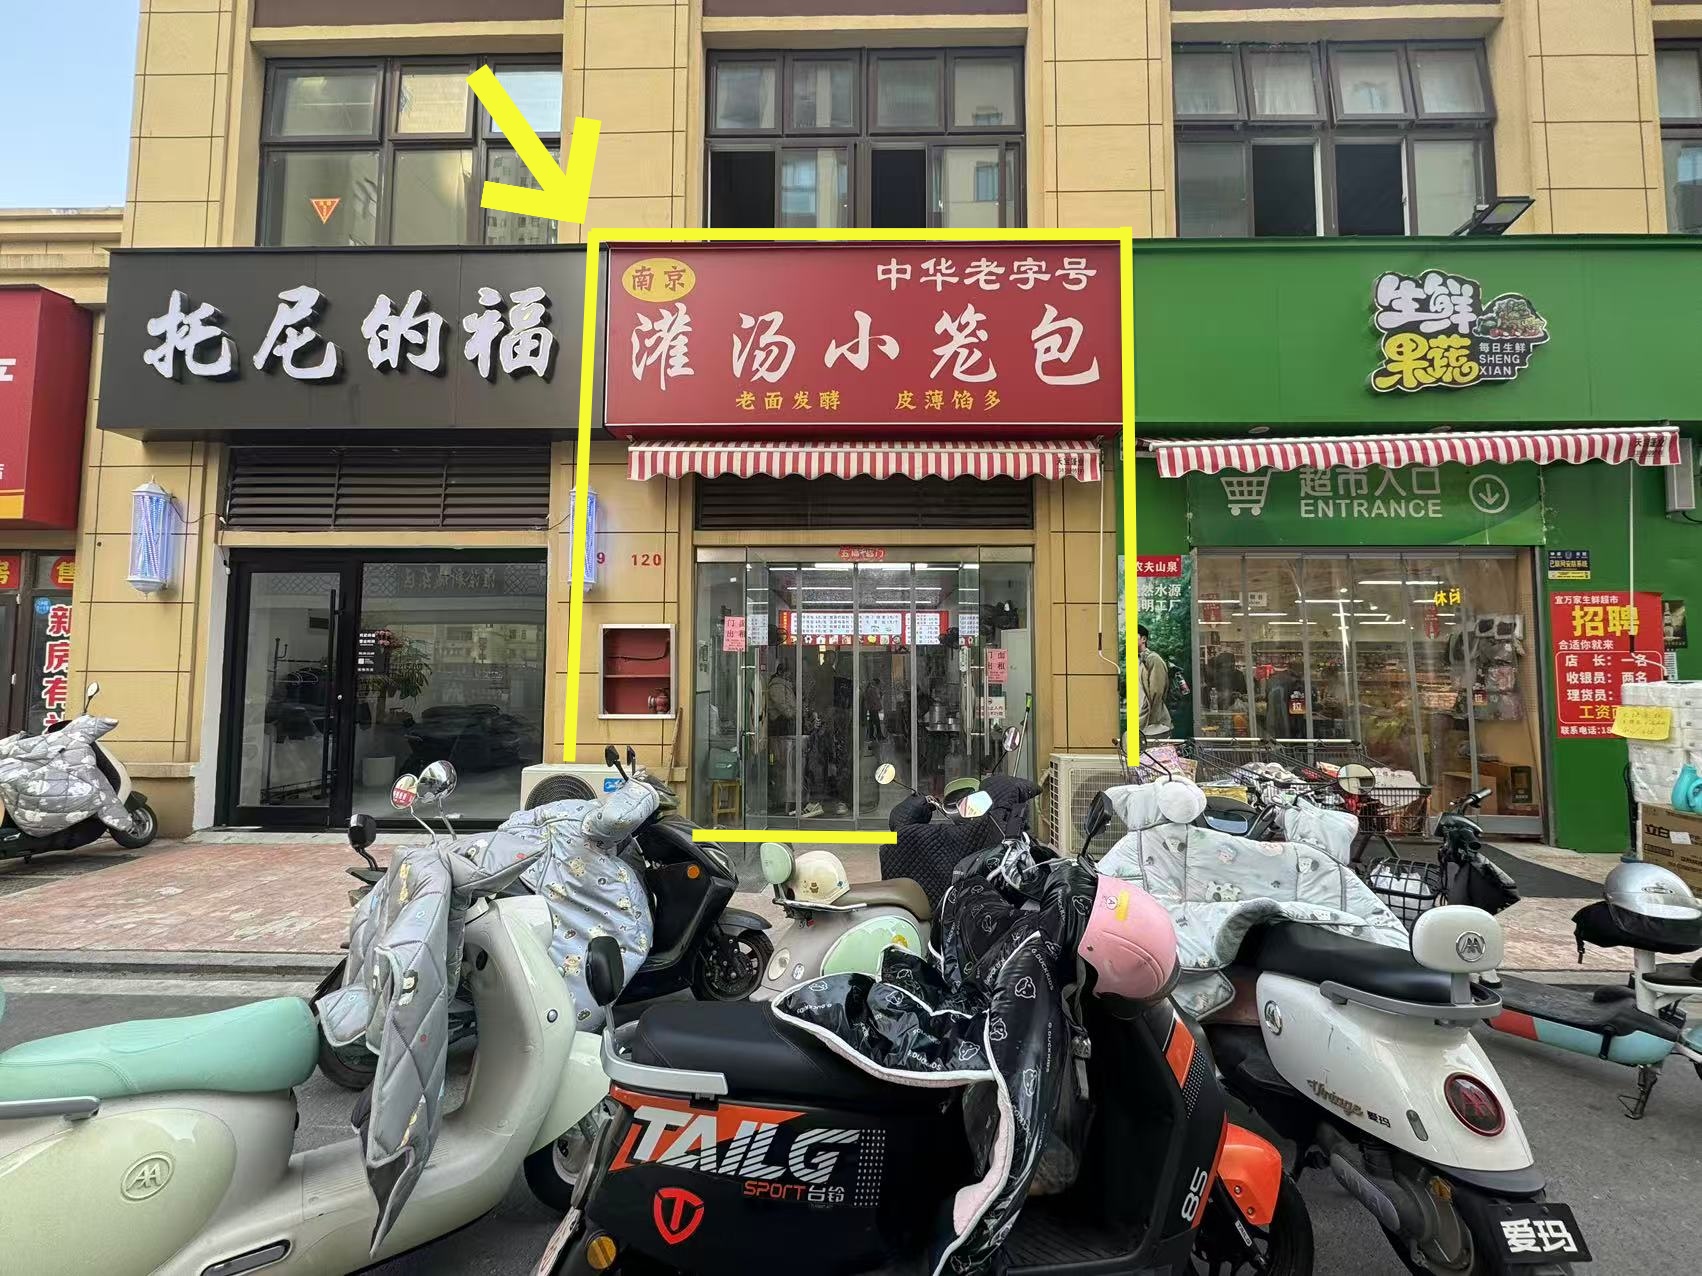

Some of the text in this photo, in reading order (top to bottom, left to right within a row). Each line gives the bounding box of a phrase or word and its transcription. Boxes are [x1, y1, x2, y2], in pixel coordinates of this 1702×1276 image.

[631, 265, 687, 292] 南京
[876, 257, 1097, 292] 中华老字号
[1377, 272, 1477, 333] 生鲜
[143, 285, 558, 381] 托尼的福
[630, 303, 1100, 391] 灌汤小笼包
[1479, 342, 1526, 353] 每日生鲜
[1375, 333, 1480, 389] 果蔬
[1479, 354, 1521, 365] SHENG
[1479, 365, 1513, 376] XIAN
[735, 390, 1002, 411] 老面发酵 皮薄馅多
[1300, 466, 1441, 497] 超市入口
[1300, 499, 1443, 518] ENTRANCE
[631, 553, 662, 566] 120
[1137, 583, 1182, 597] 然水源
[1137, 598, 1182, 612] 明工厂
[1572, 605, 1640, 637] 招聘
[1558, 640, 1614, 650] 合适你就来
[42, 603, 73, 735] 新房有
[1565, 654, 1578, 667] 店
[1621, 654, 1648, 667] 一名
[1566, 671, 1647, 684] 收银员： 两名
[1567, 689, 1613, 702] 理货员：
[633, 1104, 861, 1184] TAILG
[744, 1180, 806, 1201] SPORT
[808, 1185, 845, 1203] 台铃
[1181, 1167, 1208, 1221] 85
[1500, 1218, 1578, 1252] 爱玛
